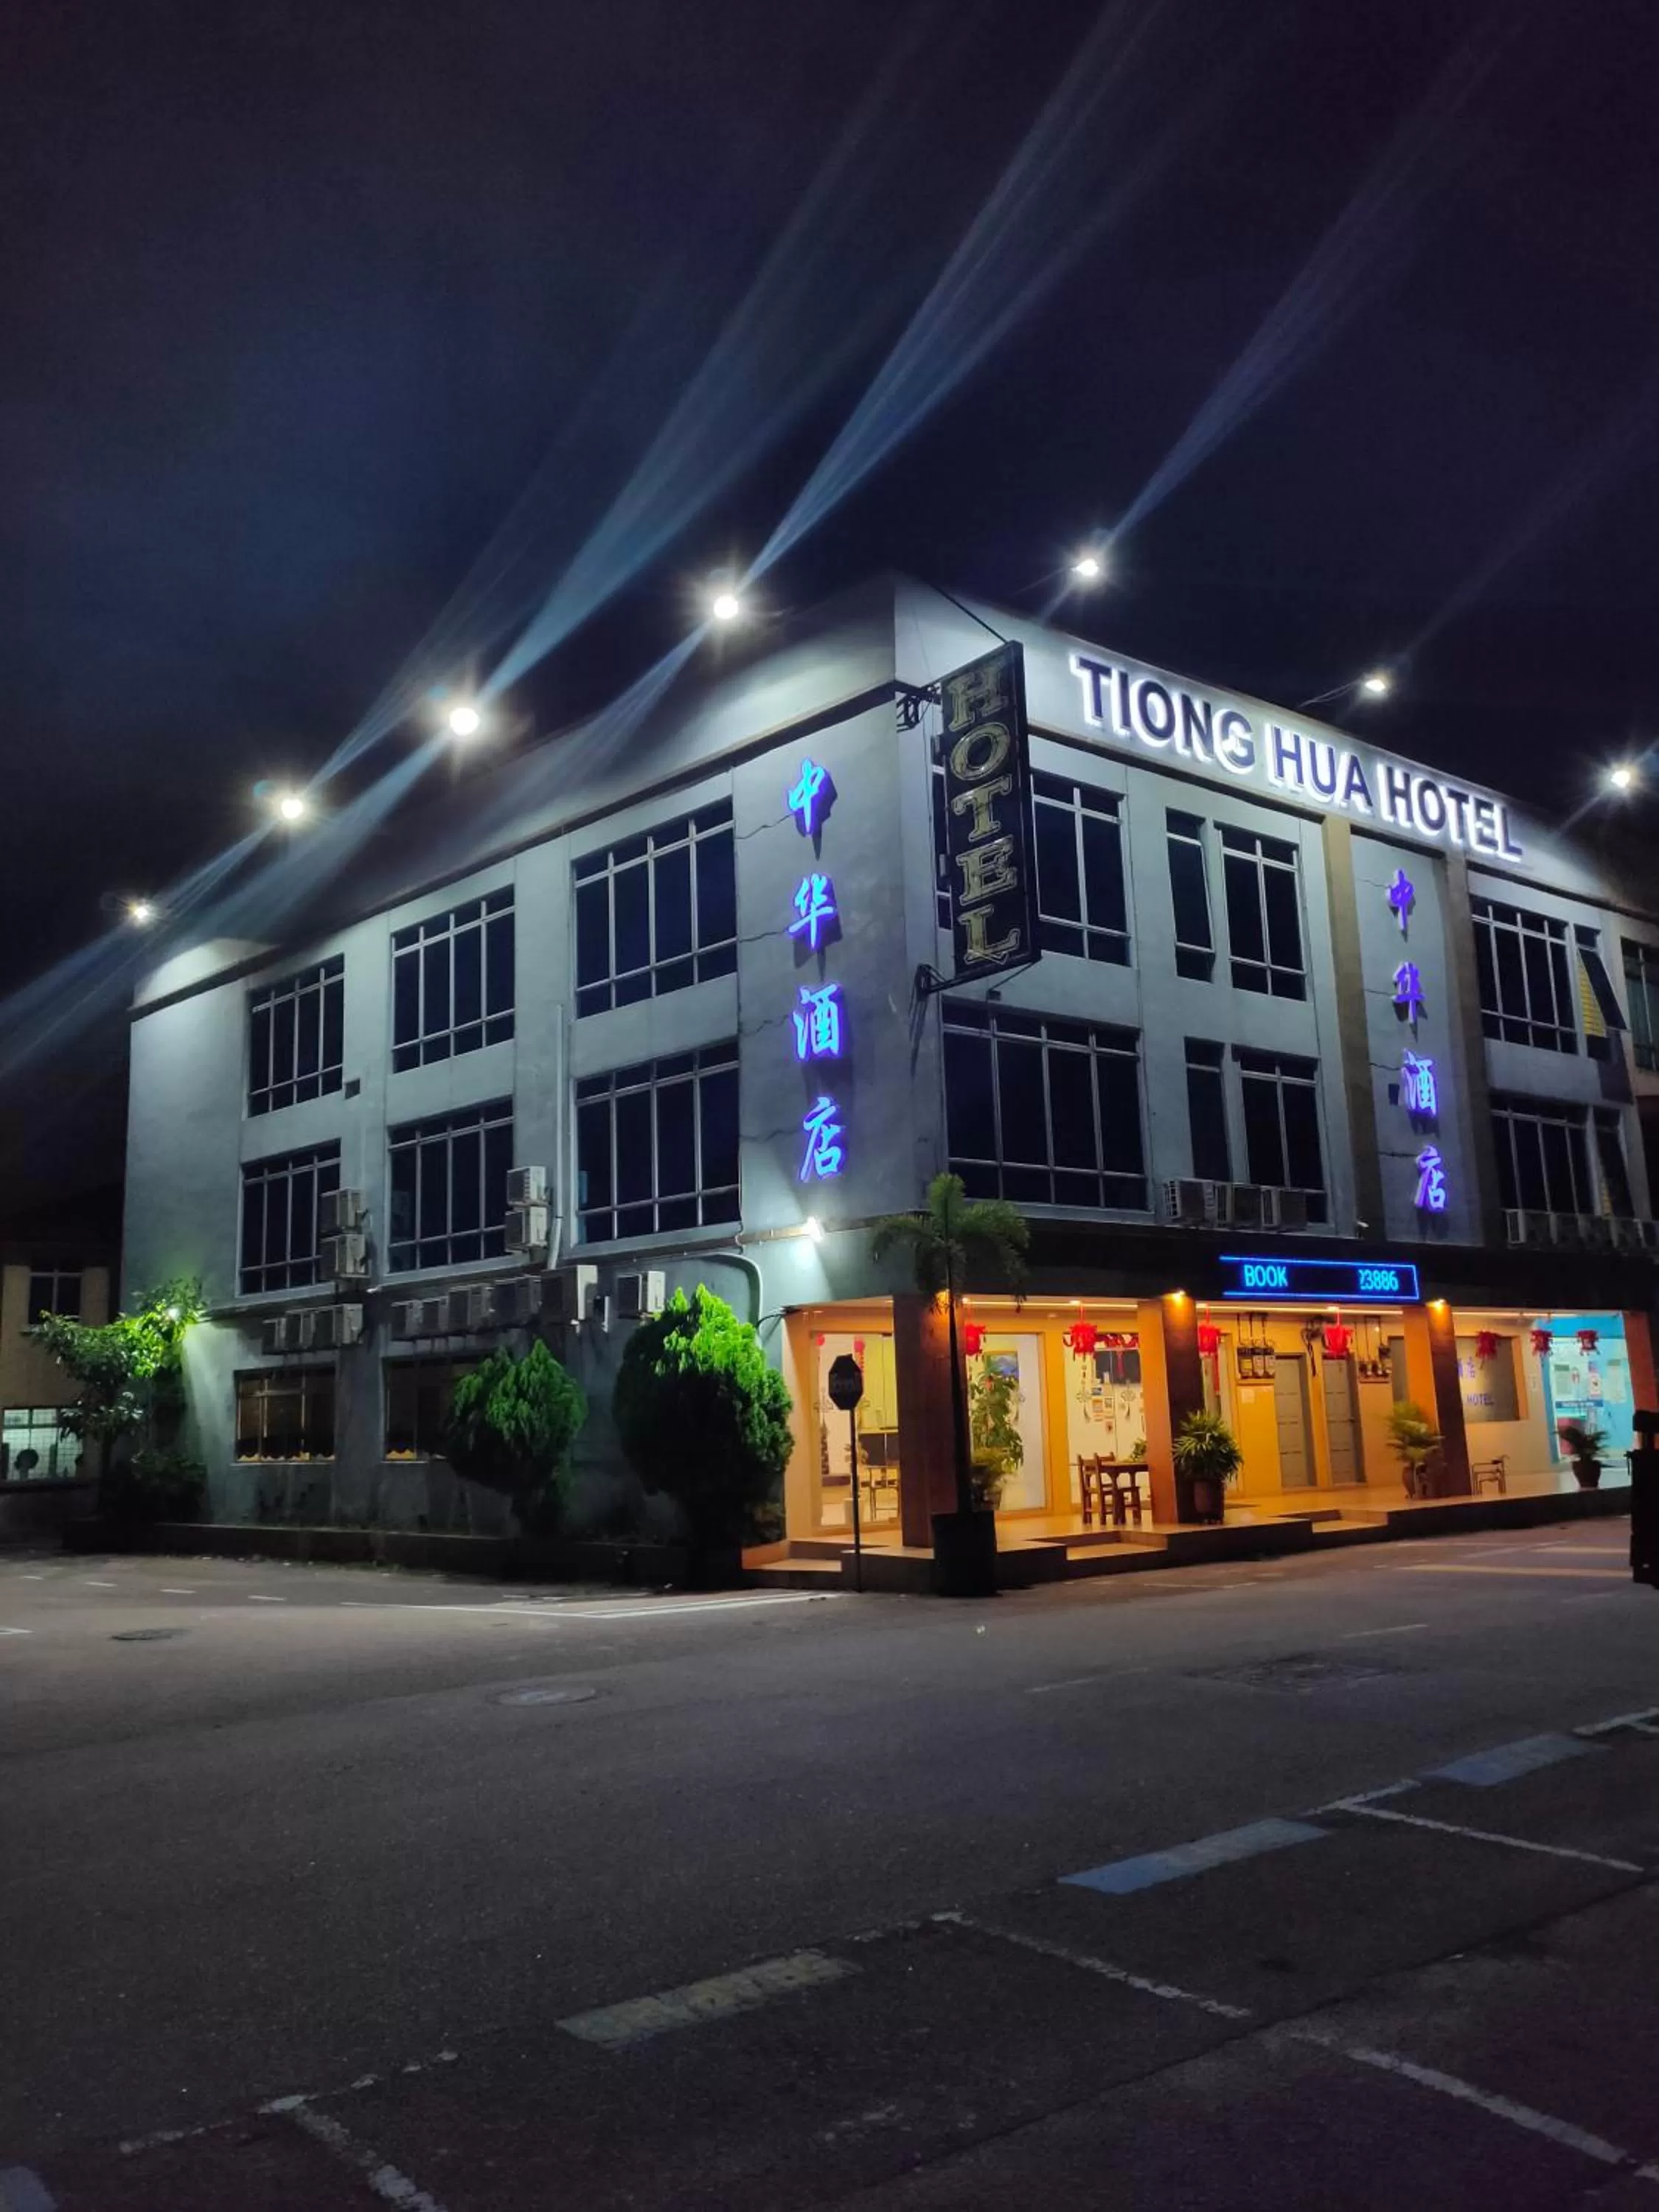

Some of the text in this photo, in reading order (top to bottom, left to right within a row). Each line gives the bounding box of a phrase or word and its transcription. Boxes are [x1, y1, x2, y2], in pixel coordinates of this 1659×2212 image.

[948, 661, 1020, 965] HOTEL
[1074, 654, 1523, 860] TIONG HUA HOTEL
[787, 759, 842, 1183] 中华酒店
[1244, 1265, 1288, 1287] BOOK
